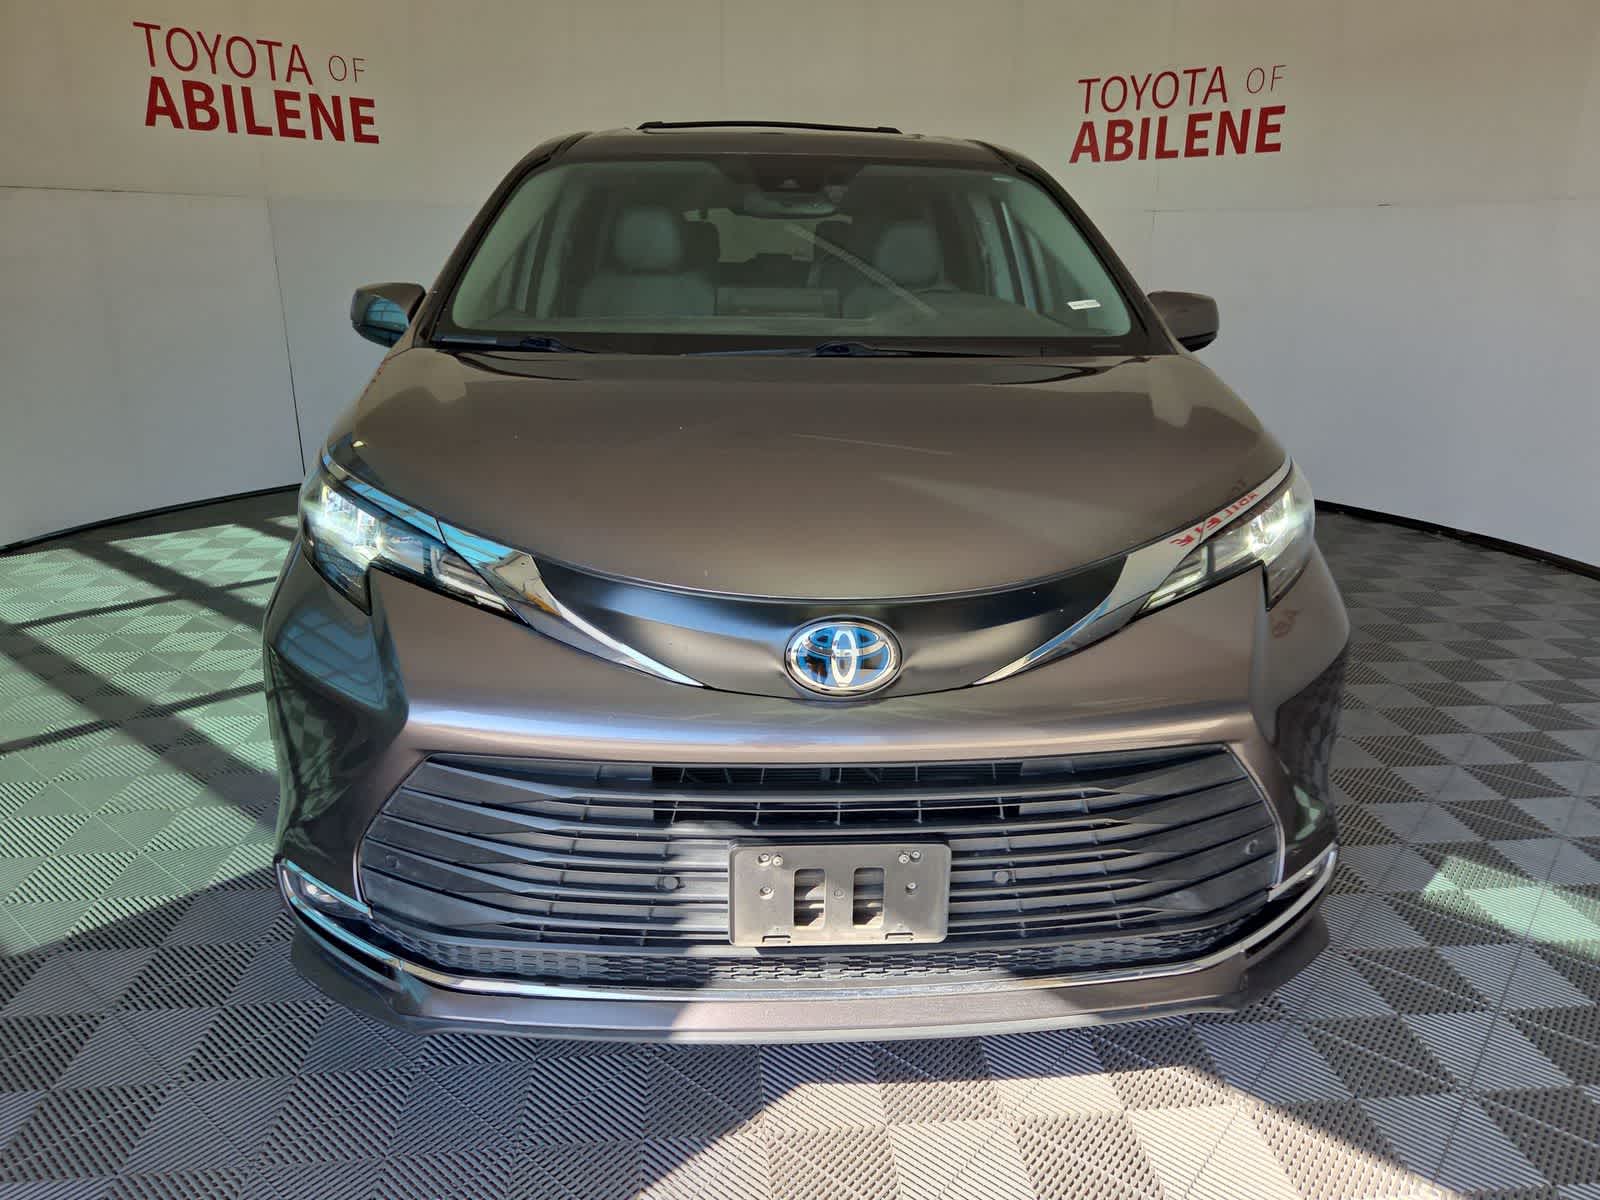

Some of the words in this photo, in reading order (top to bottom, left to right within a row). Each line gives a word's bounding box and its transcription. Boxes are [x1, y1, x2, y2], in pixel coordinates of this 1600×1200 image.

[133, 21, 313, 85] TOYOTA
[328, 55, 365, 83] OF
[145, 76, 379, 144] ABILENE
[1078, 66, 1228, 114] TOYOTA
[1246, 64, 1287, 94] OF
[1069, 105, 1286, 163] ABILENE
